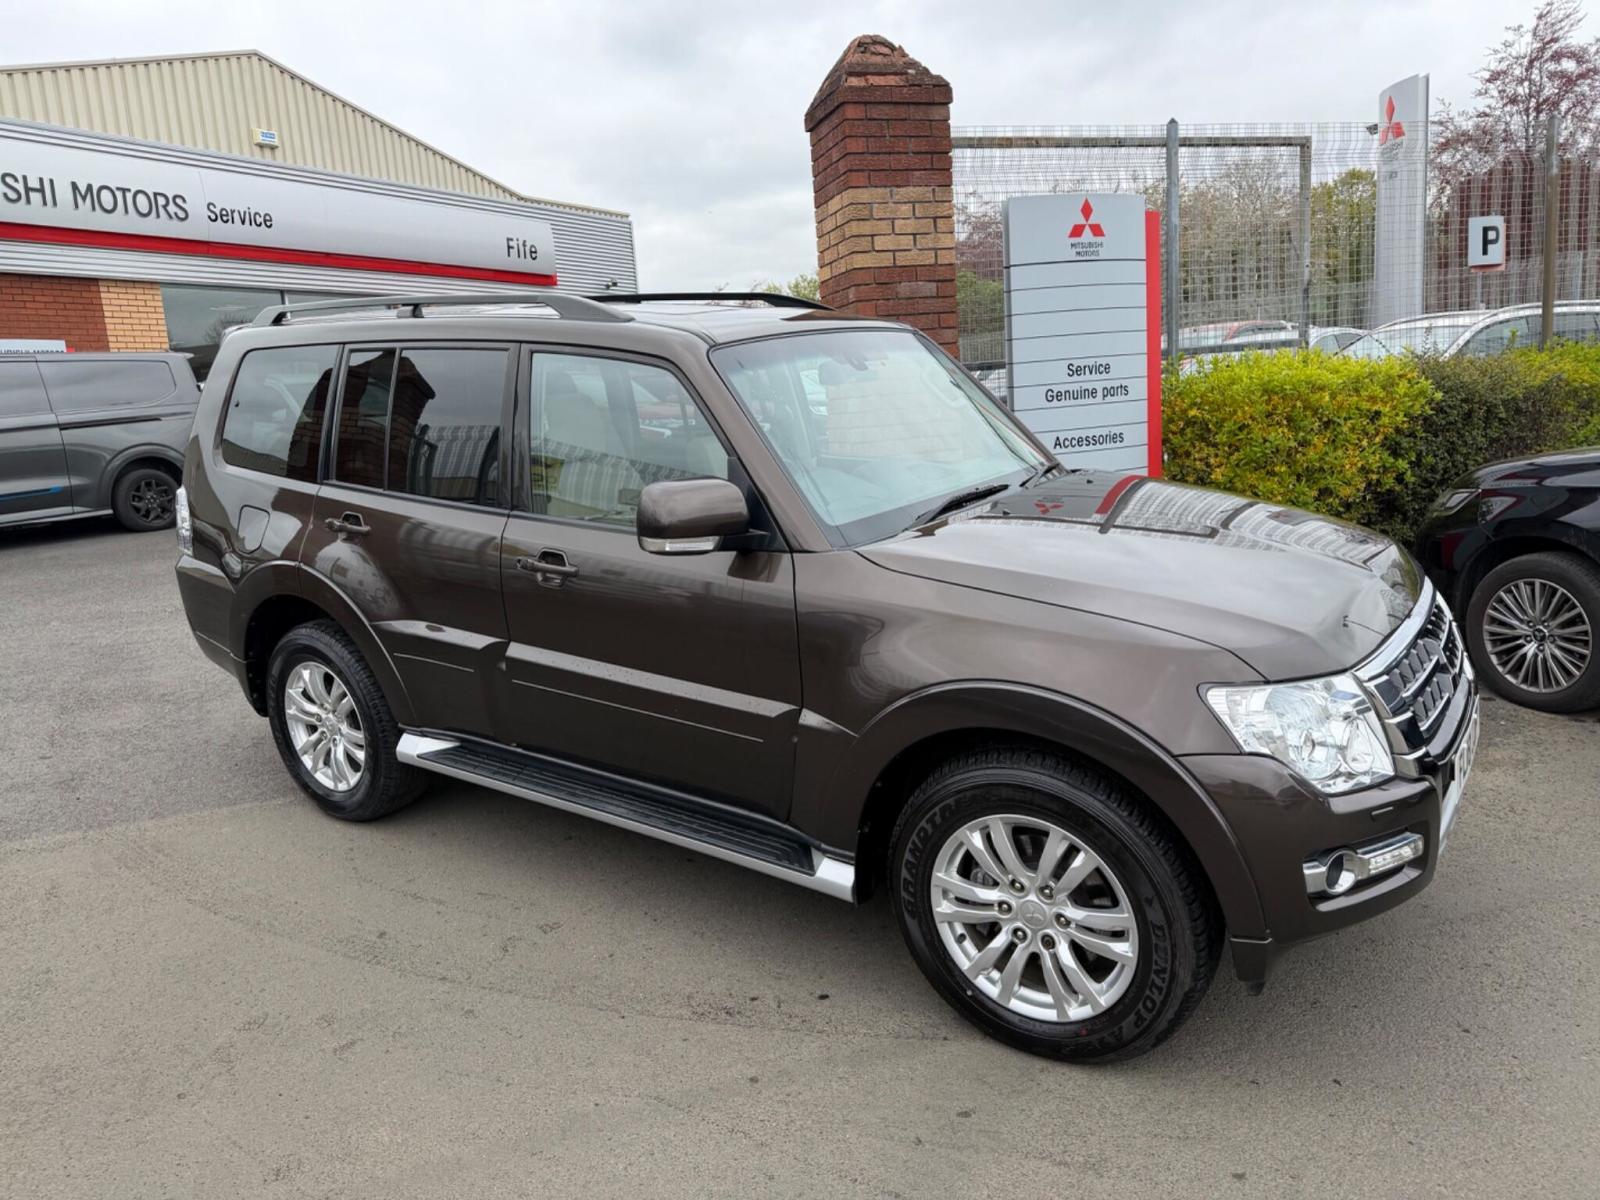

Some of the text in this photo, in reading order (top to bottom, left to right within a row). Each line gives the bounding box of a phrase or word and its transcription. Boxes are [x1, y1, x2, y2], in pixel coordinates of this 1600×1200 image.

[71, 181, 189, 222] MOTORS
[207, 202, 273, 229] Service
[506, 236, 538, 260] Fife
[1482, 225, 1500, 256] P
[1075, 249, 1101, 257] MOTORS
[1067, 361, 1111, 377] Service
[1045, 383, 1129, 403] Genuine parts
[1053, 430, 1124, 450] Accessories
[1134, 922, 1170, 1029] DUNLOP
